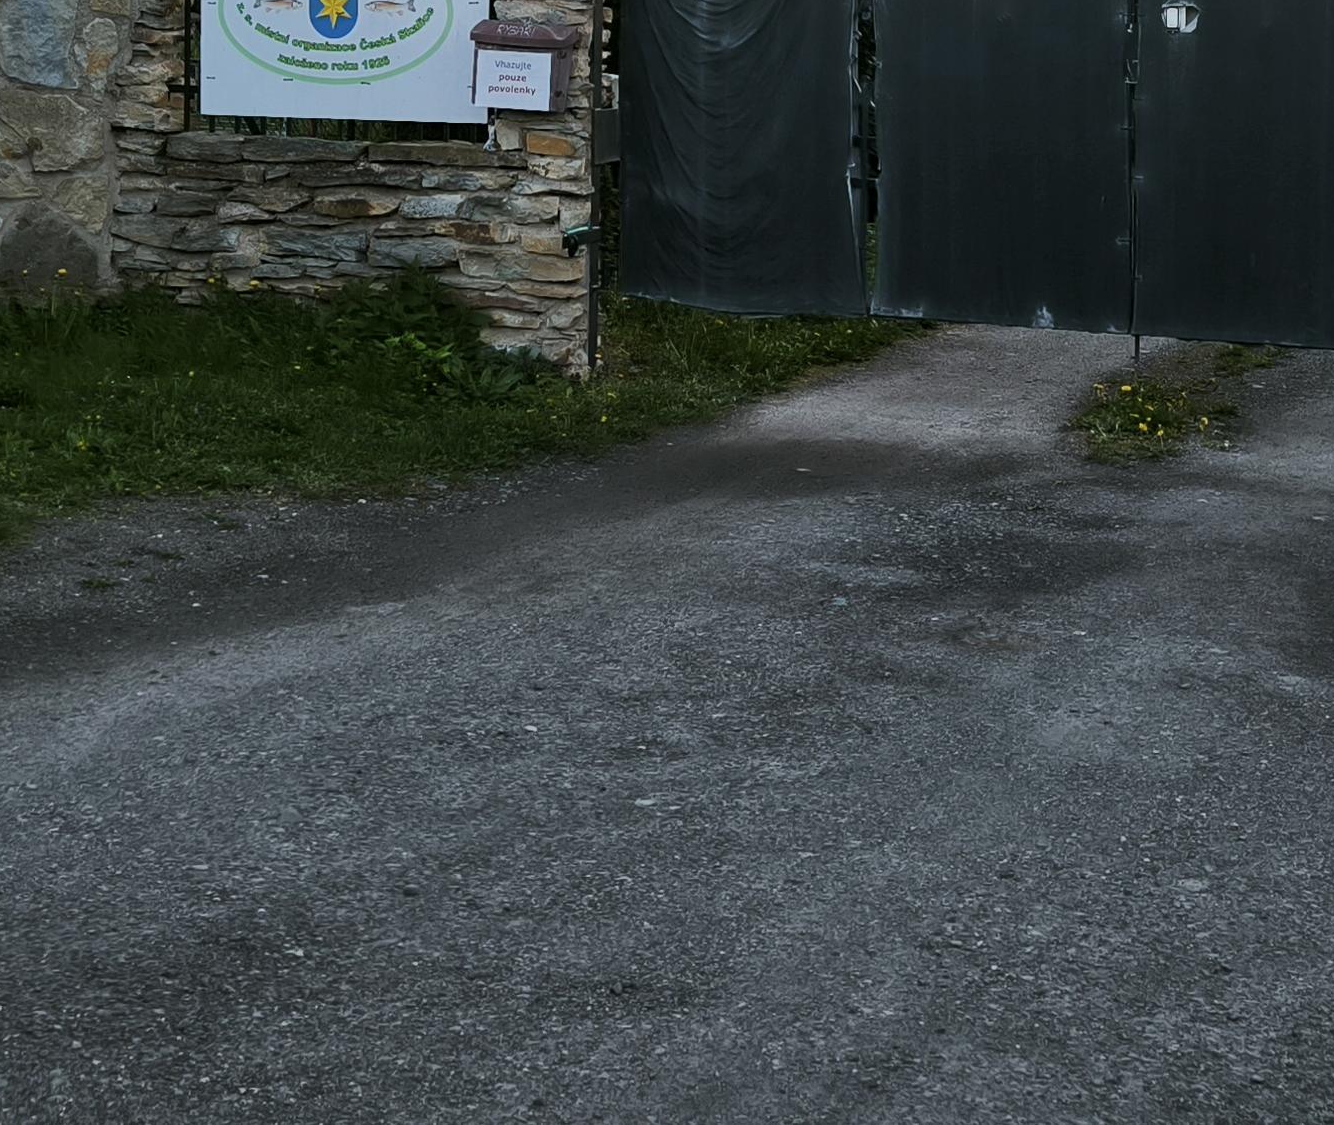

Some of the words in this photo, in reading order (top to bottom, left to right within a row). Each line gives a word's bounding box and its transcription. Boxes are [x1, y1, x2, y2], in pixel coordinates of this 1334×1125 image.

[292, 39, 357, 52] organizace
[360, 33, 396, 50] Česká
[398, 7, 435, 41] Skalice
[495, 60, 532, 70] Vhazujte
[499, 74, 527, 82] pouze
[488, 85, 536, 96] povolenky
